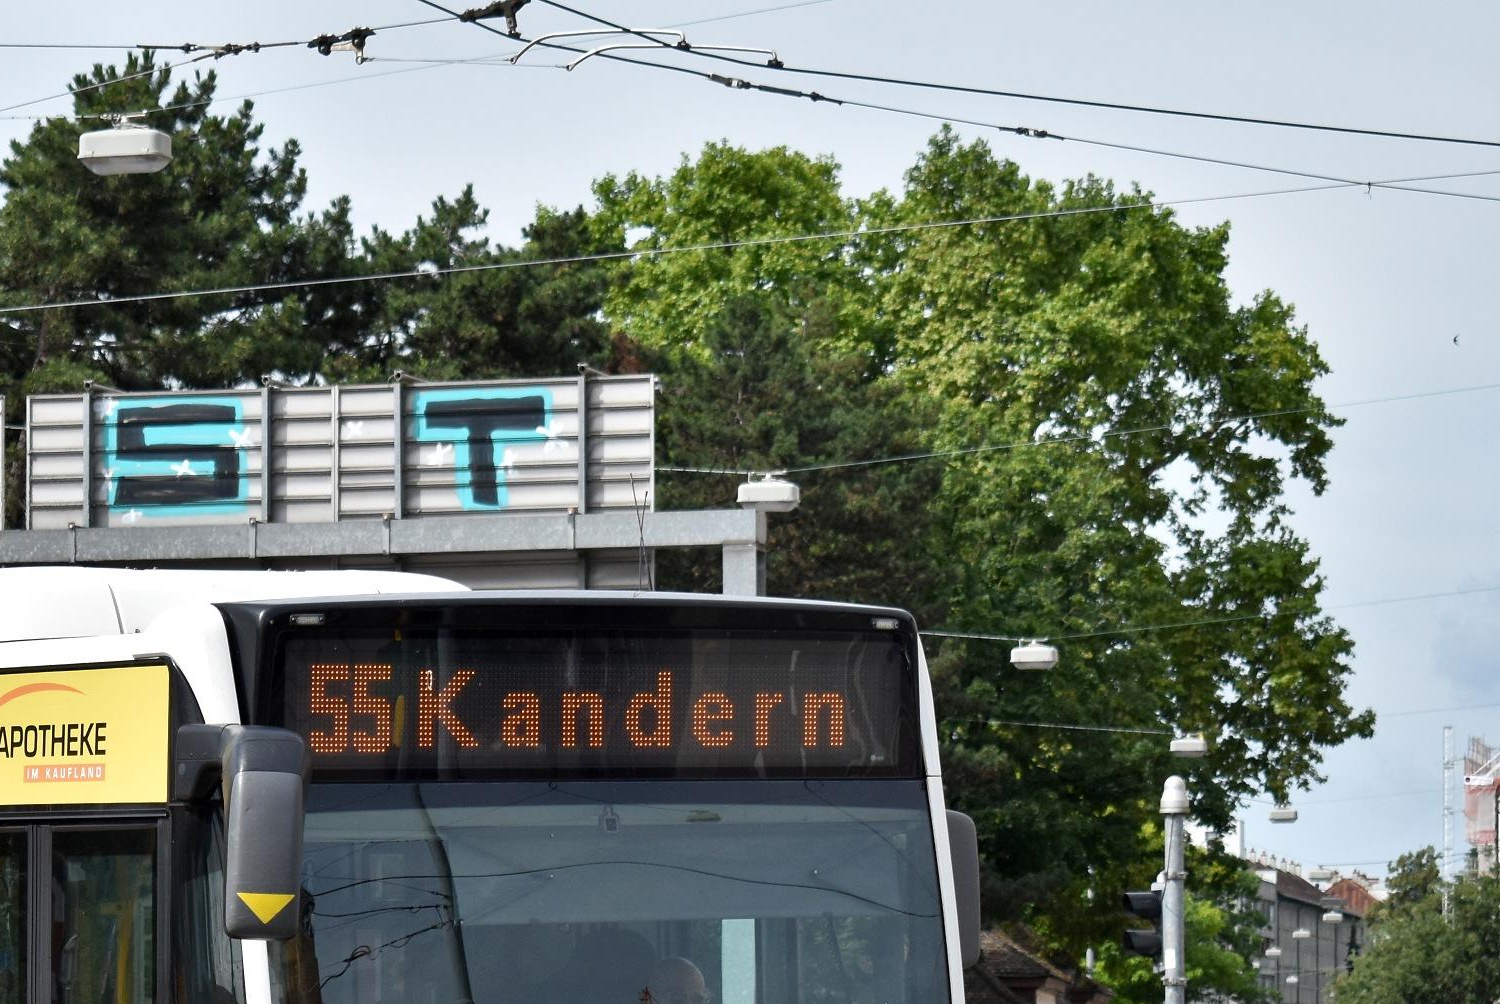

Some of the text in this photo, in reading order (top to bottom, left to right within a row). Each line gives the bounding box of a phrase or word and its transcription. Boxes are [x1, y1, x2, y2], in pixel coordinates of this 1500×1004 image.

[310, 664, 845, 753] 55 Kandern
[26, 766, 102, 780] IM KAUFLAND
